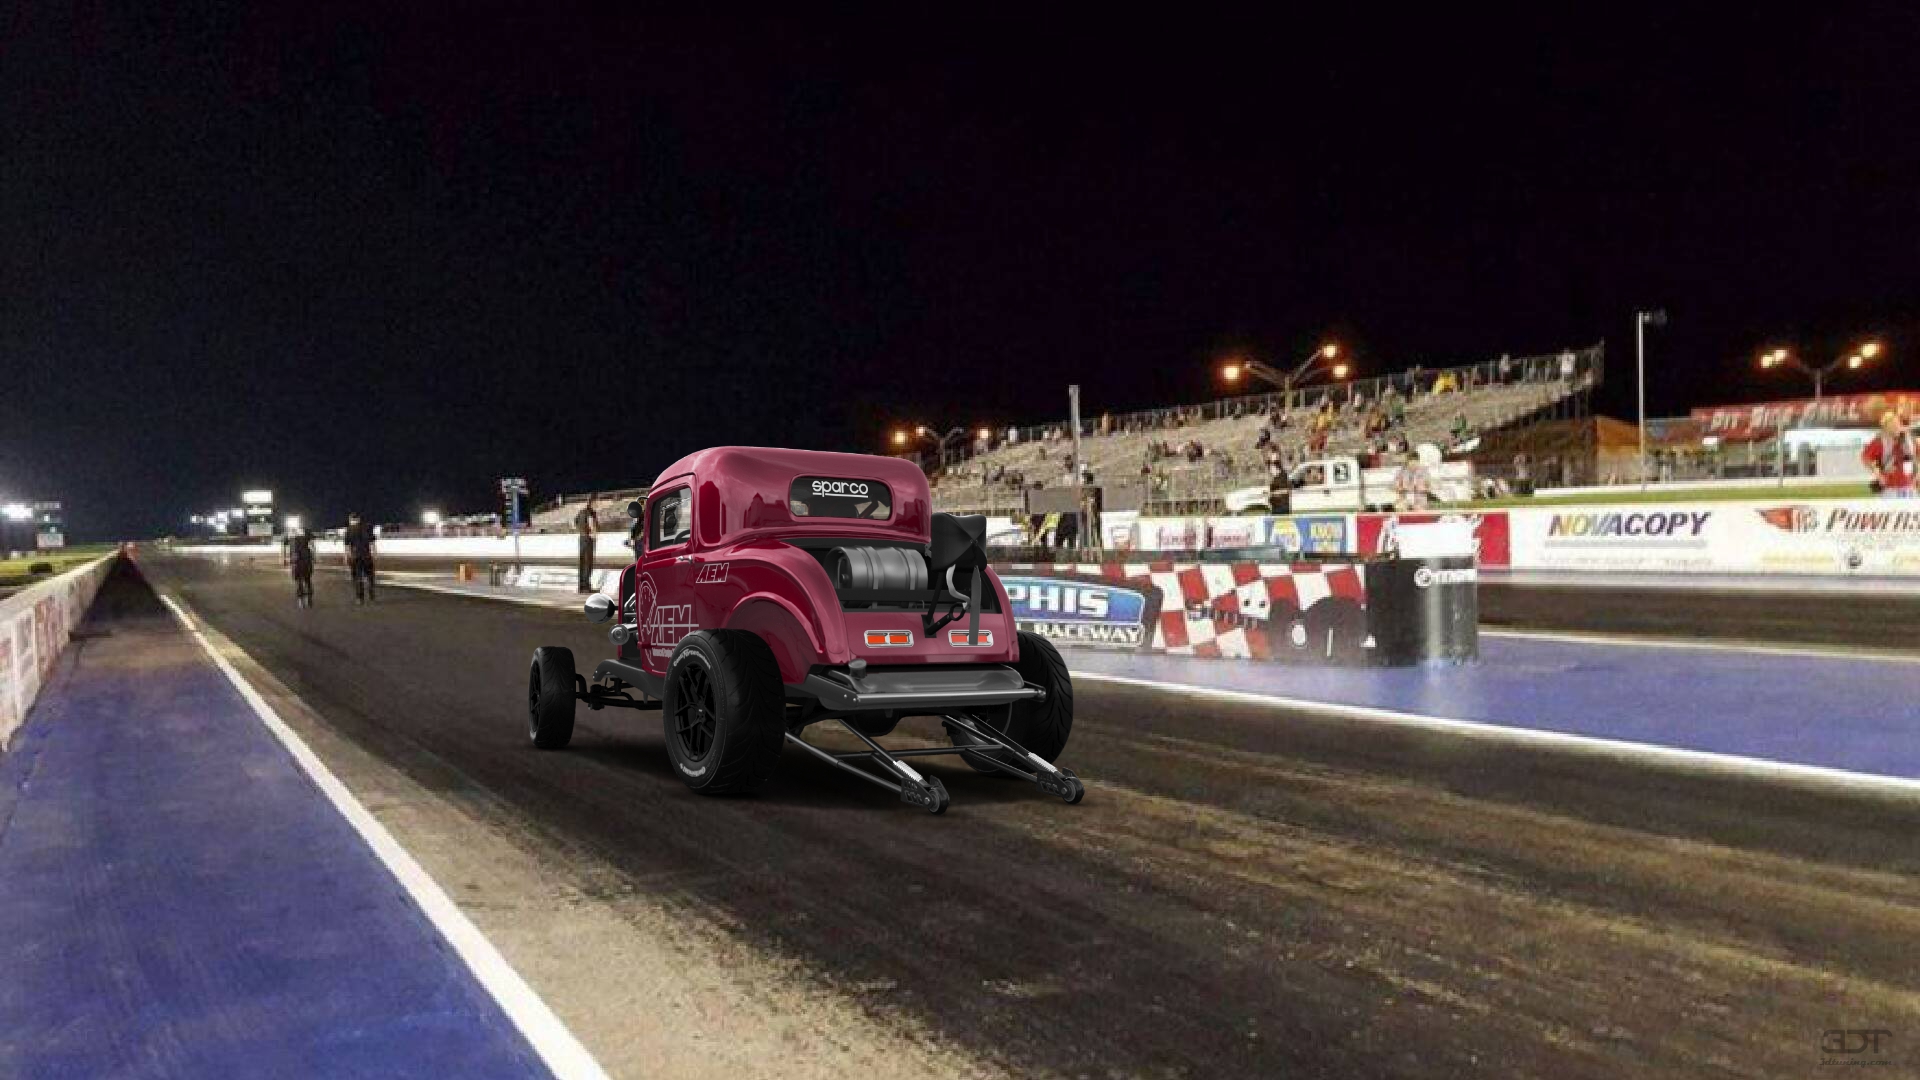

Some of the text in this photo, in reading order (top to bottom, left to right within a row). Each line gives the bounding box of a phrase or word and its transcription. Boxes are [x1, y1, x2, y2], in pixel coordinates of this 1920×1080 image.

[812, 480, 869, 498] sparco
[1549, 511, 1712, 536] NOVACOPY
[696, 562, 730, 584] AEM
[651, 604, 692, 646] AEM
[1033, 622, 1142, 642] RACEWAY
